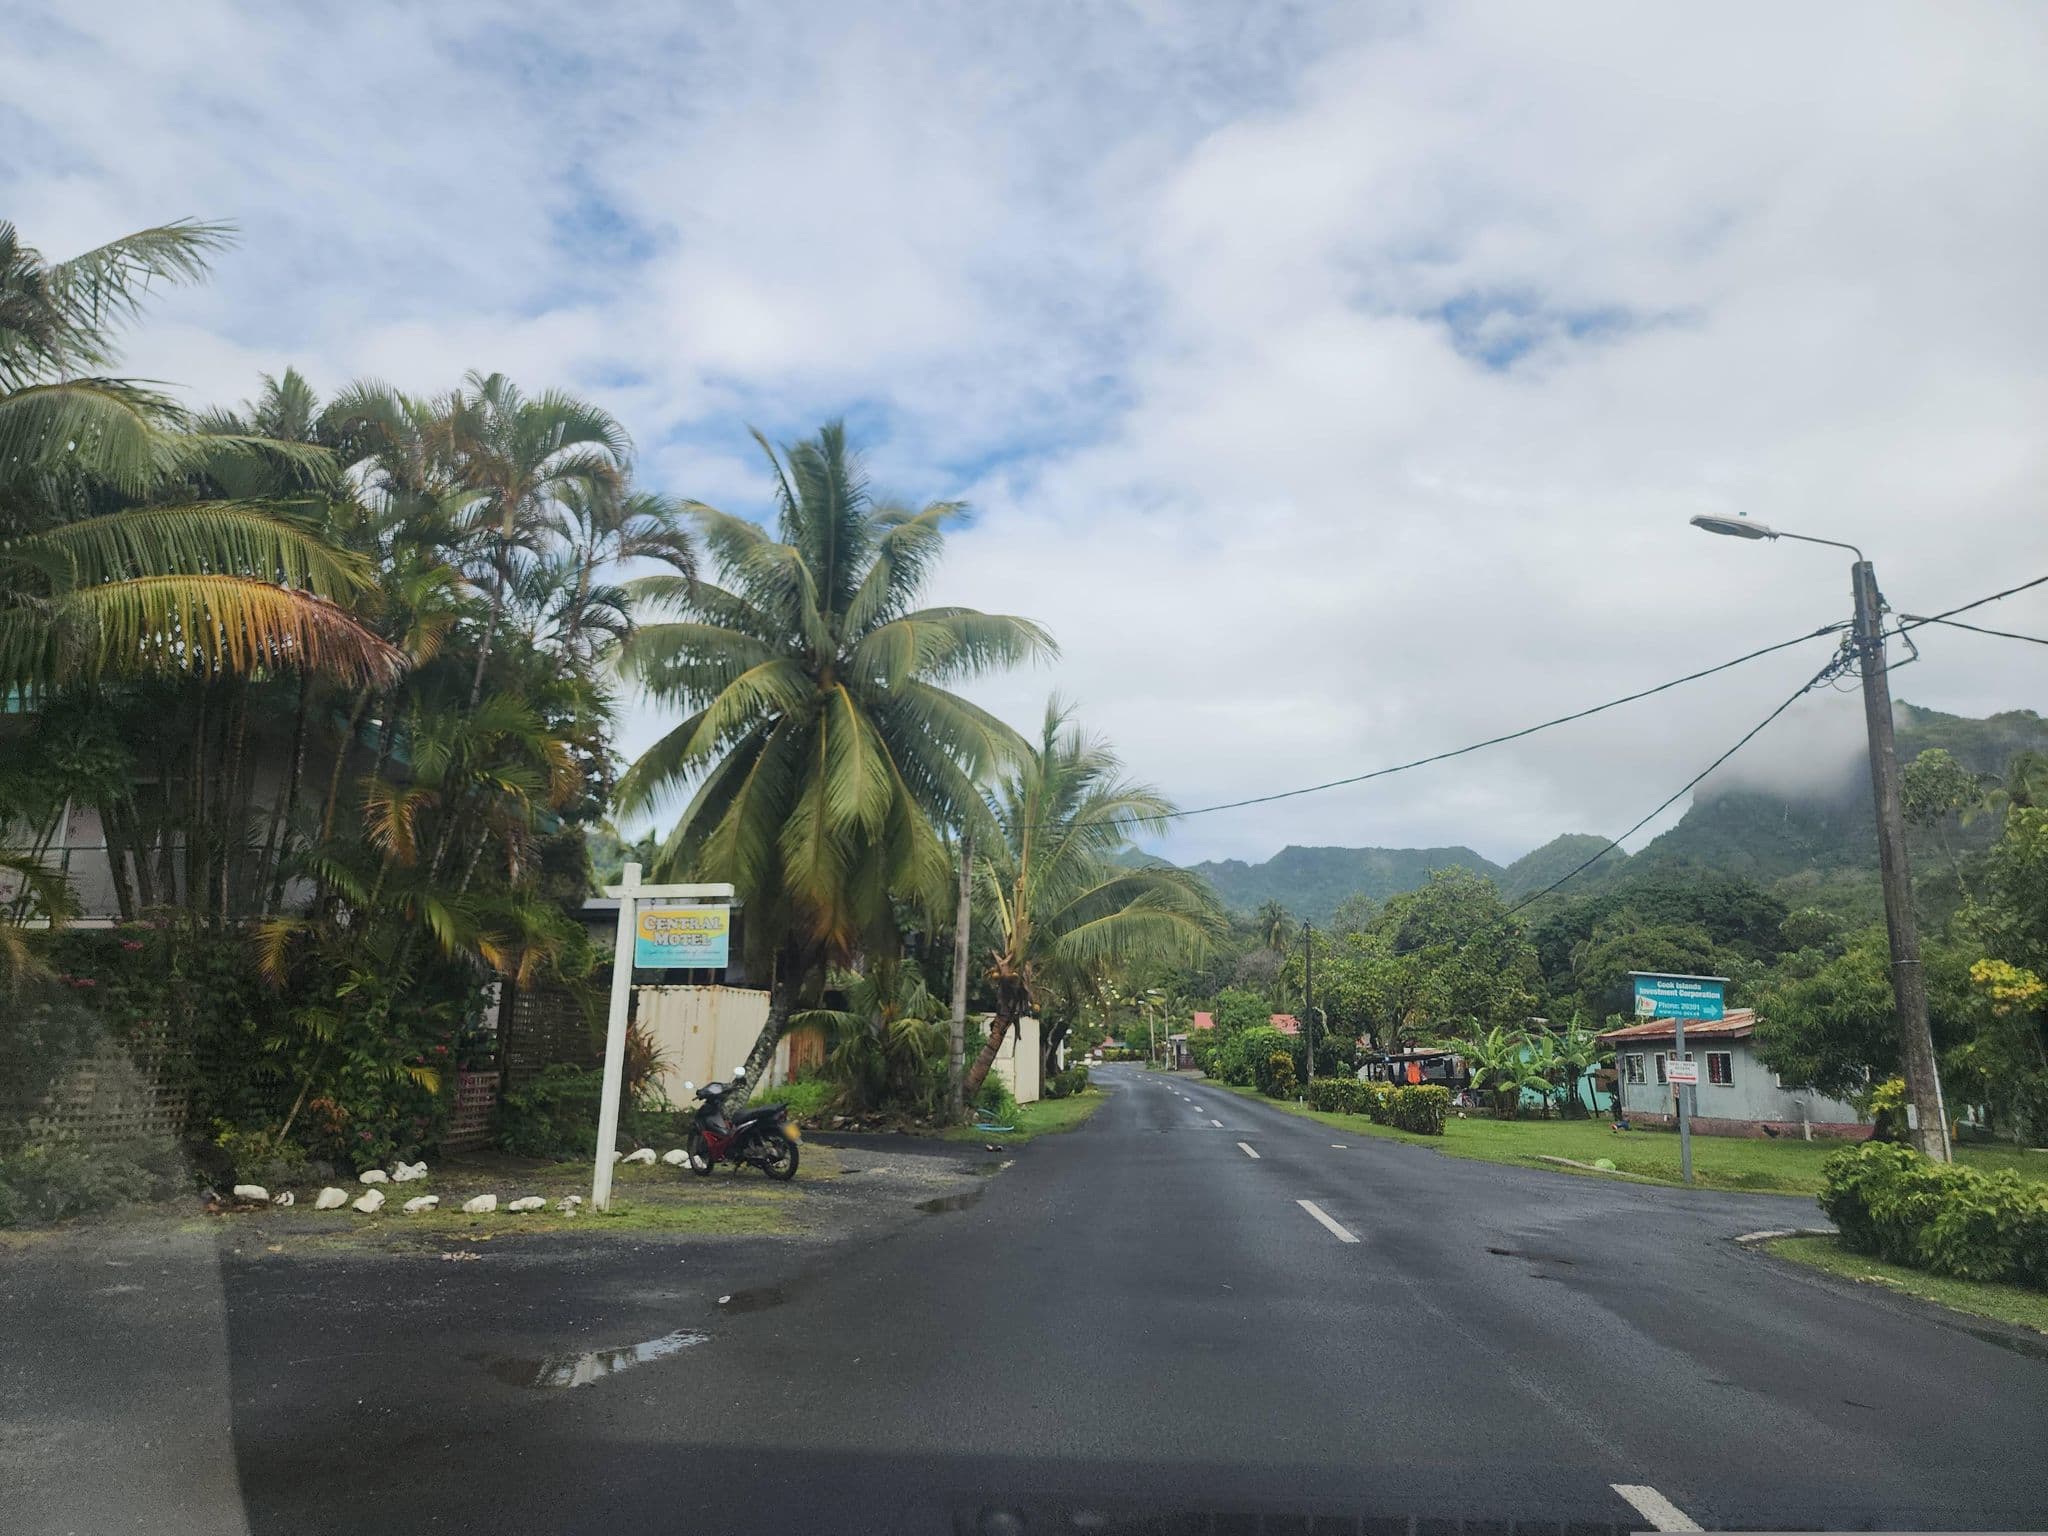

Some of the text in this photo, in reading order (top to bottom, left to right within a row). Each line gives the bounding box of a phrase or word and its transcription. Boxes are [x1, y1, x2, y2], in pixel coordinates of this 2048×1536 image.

[643, 915, 723, 930] CENTRAL
[655, 932, 712, 946] MOTEL
[1657, 981, 1675, 989] Cook
[1640, 988, 1720, 998] Investment Corporation
